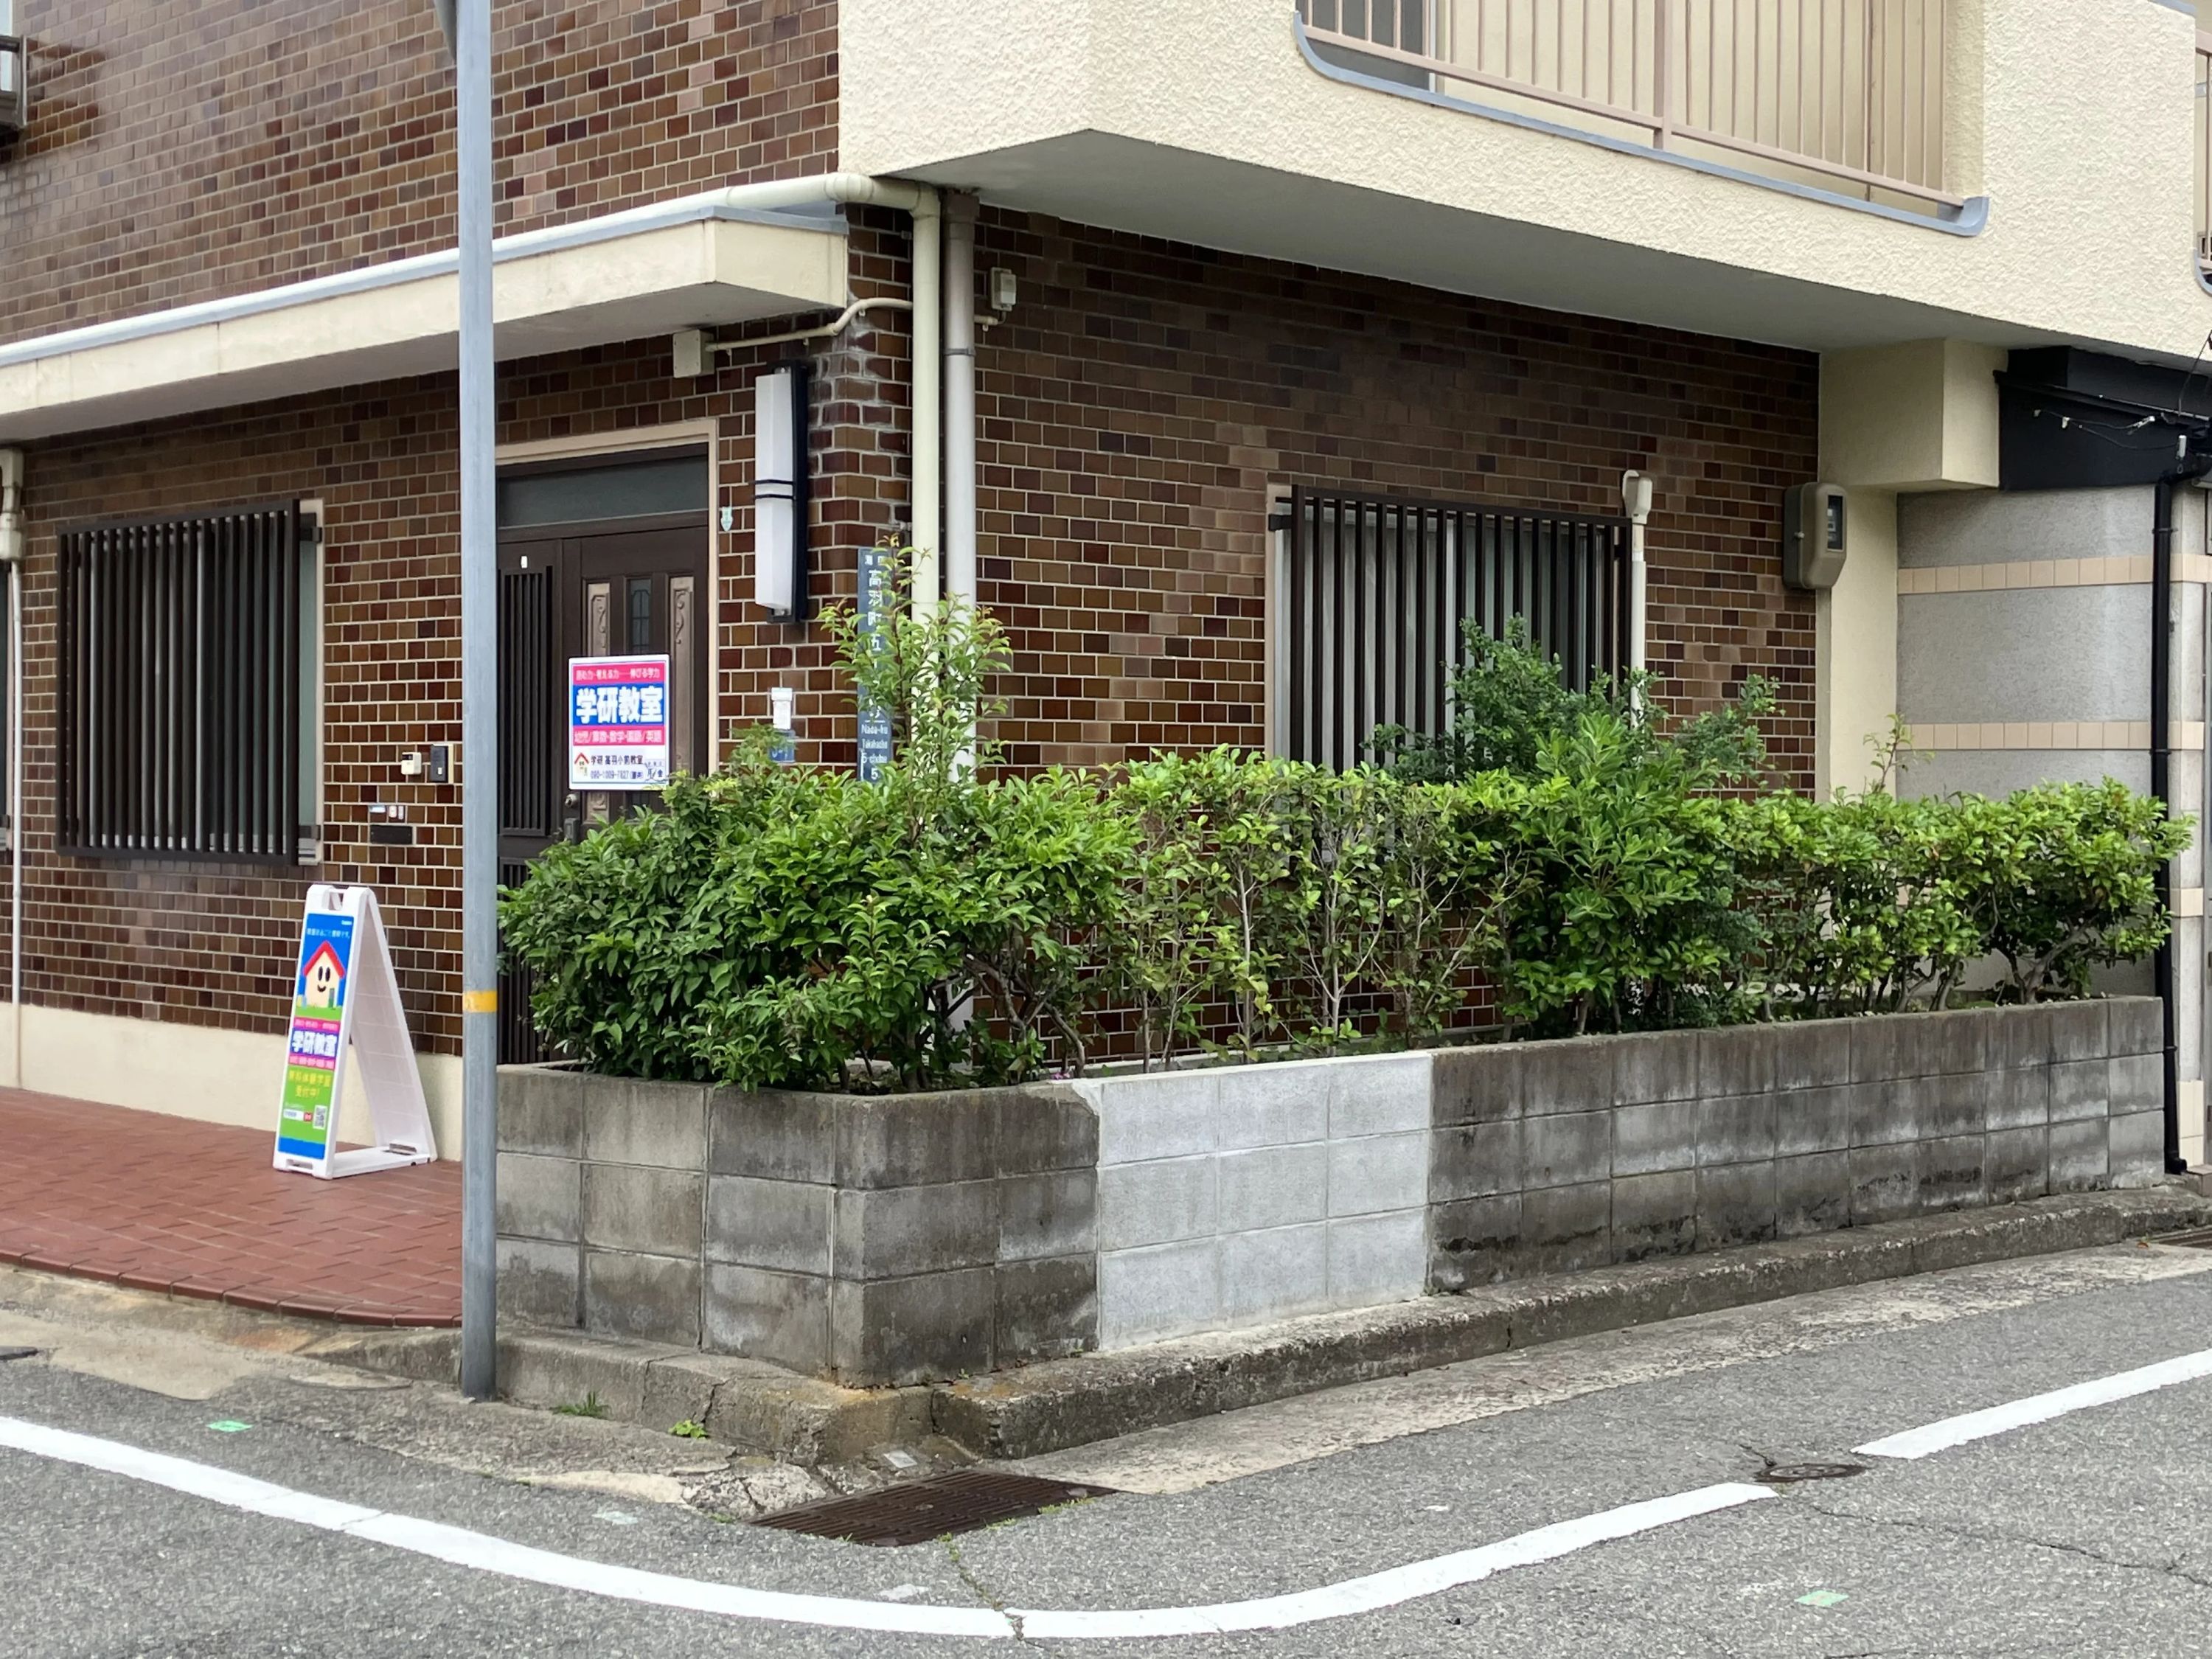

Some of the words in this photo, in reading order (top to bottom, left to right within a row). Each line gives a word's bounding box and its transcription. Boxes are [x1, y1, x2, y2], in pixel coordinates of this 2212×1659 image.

[576, 686, 663, 724] 学研教室
[292, 1031, 337, 1057] 学研教室
